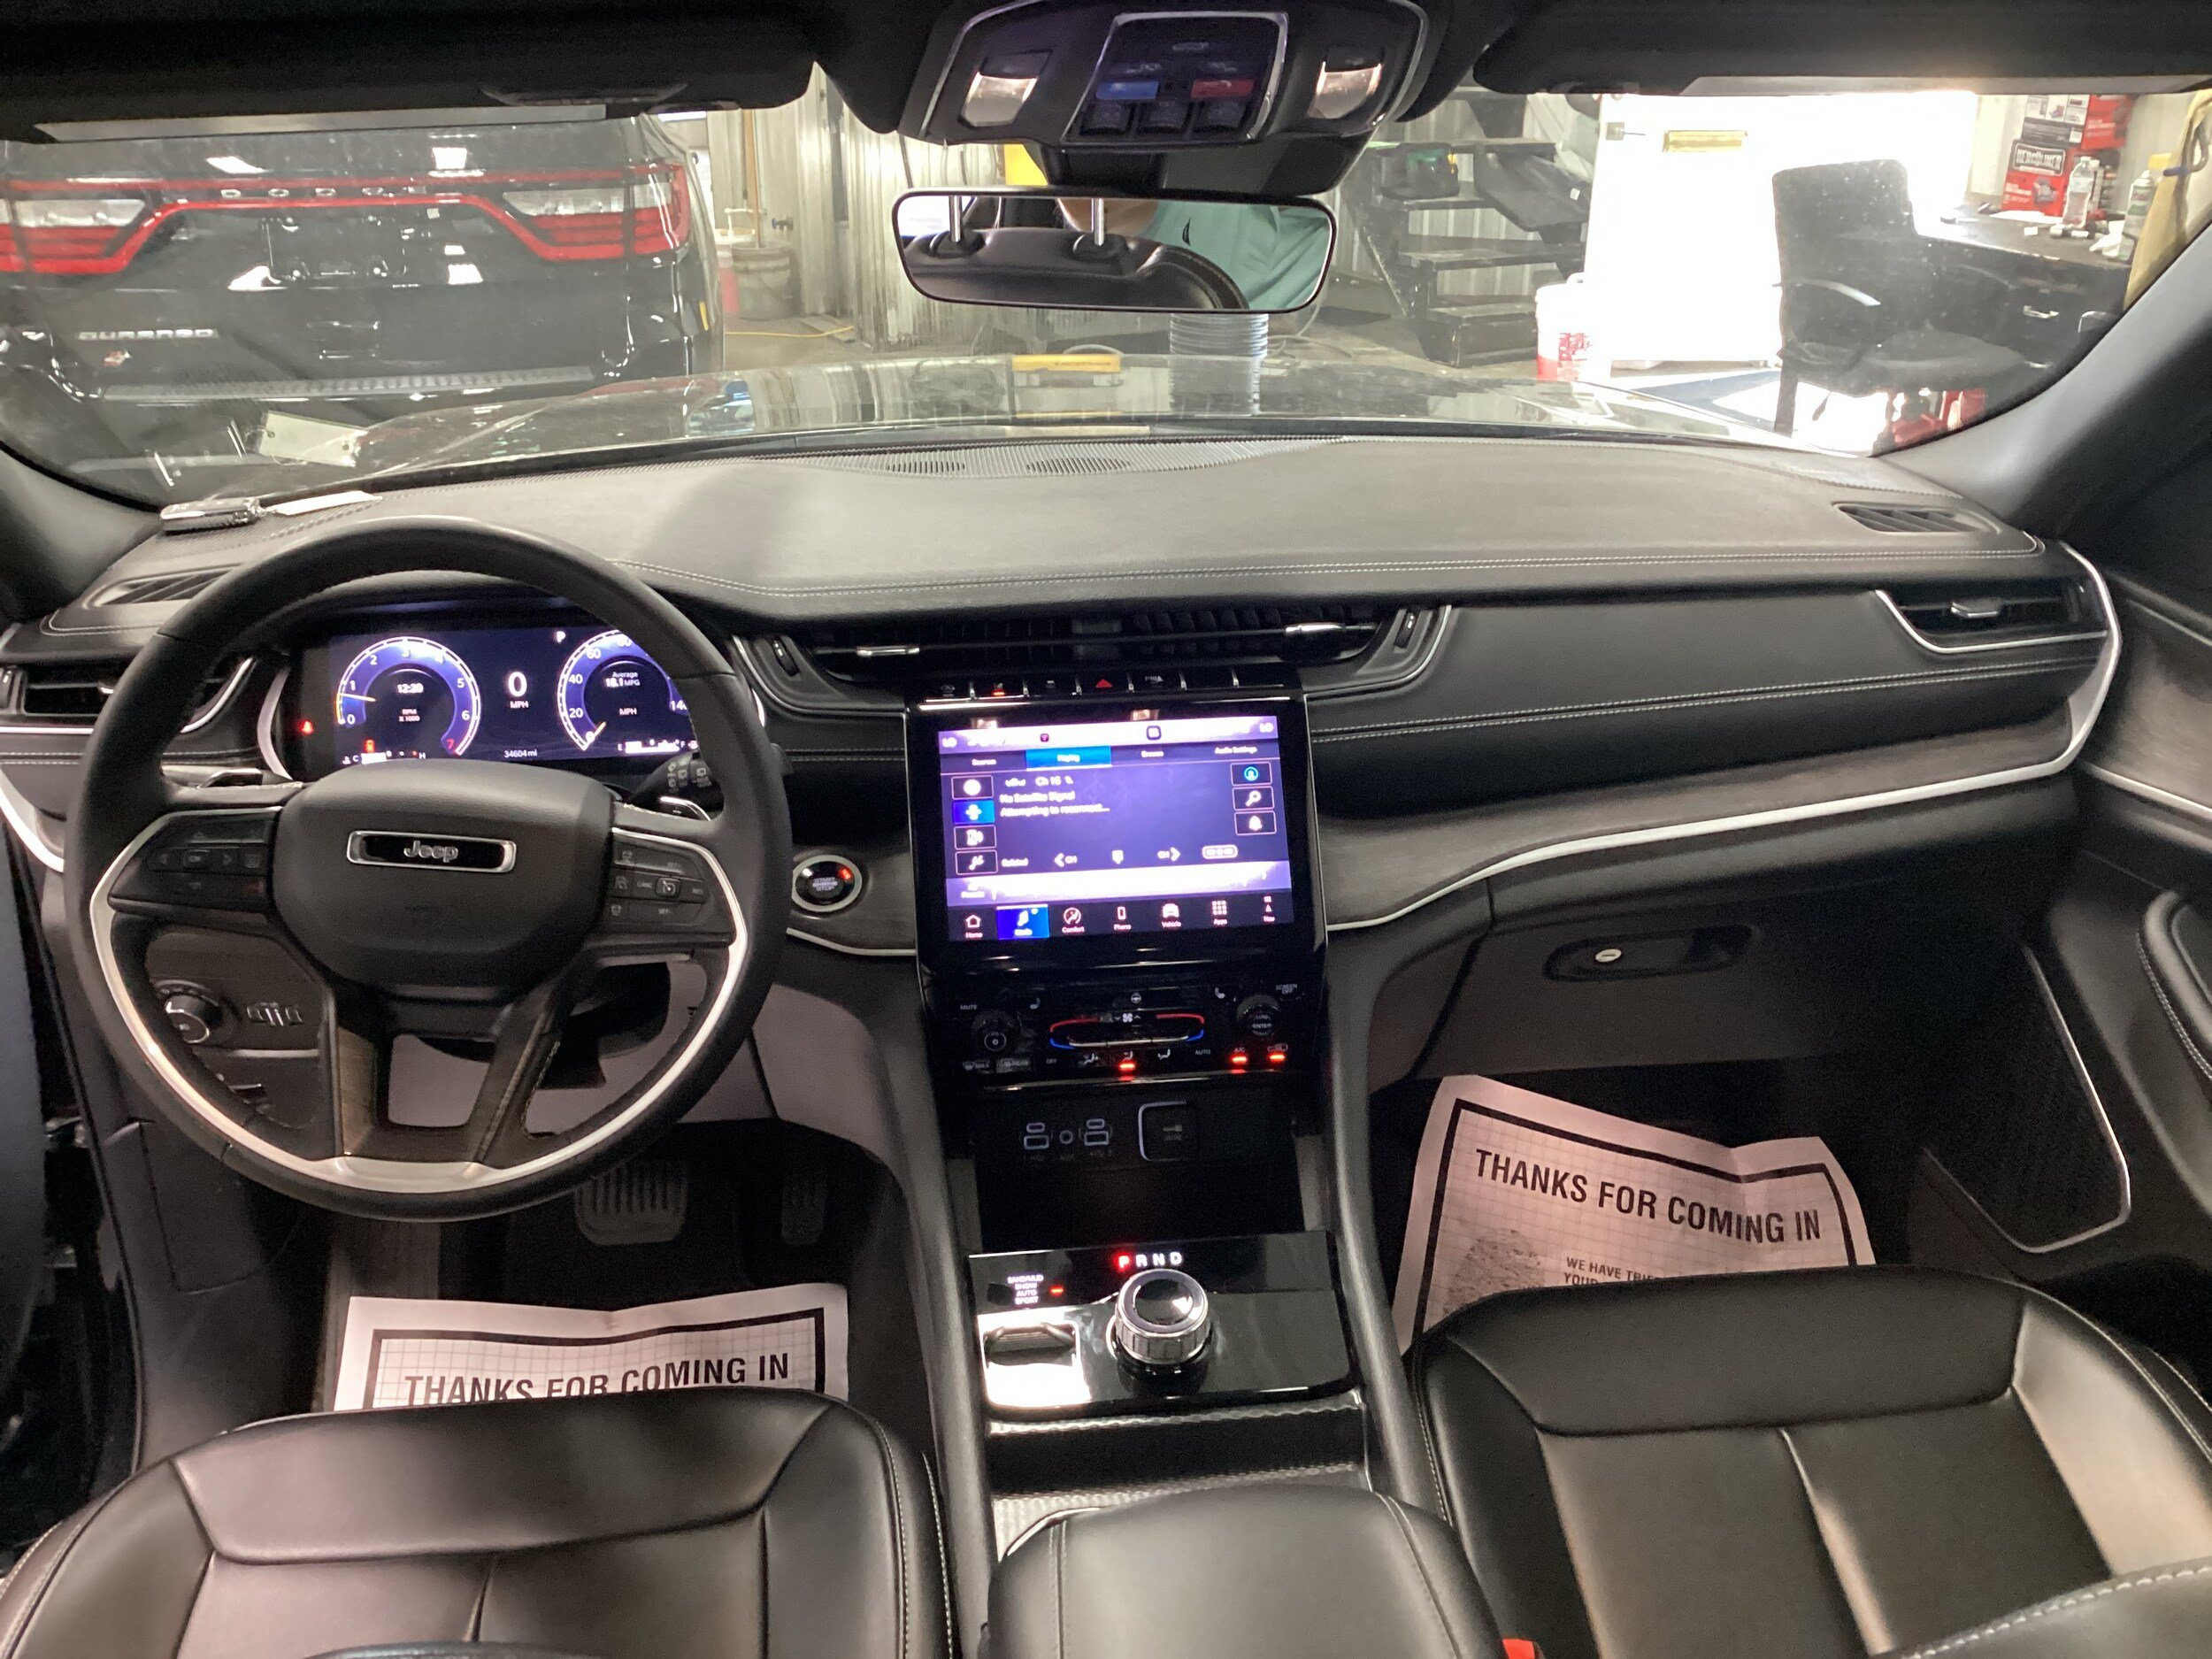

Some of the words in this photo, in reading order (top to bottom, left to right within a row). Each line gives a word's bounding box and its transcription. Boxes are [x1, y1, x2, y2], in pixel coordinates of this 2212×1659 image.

[370, 655, 378, 665] 2
[457, 679, 465, 688] 5
[508, 672, 527, 697] 0
[569, 674, 583, 684] 40
[347, 714, 356, 724] 0
[462, 710, 470, 720] 6
[570, 708, 583, 718] 20
[403, 840, 458, 863] Jeep
[1476, 1148, 1587, 1202] THANKS
[1599, 1181, 1657, 1219] FOR
[1668, 1196, 1785, 1244] COMING
[1795, 1209, 1821, 1241] IN
[1118, 1256, 1130, 1268] P
[1136, 1254, 1148, 1267] R
[1153, 1253, 1165, 1265] N
[1170, 1252, 1182, 1264] D
[1566, 1256, 1586, 1271] WE
[1589, 1262, 1621, 1279] HAVE
[405, 1376, 534, 1406] THANKS
[548, 1374, 609, 1398] FOR
[621, 1357, 746, 1393] COMING
[759, 1353, 788, 1381] IN
